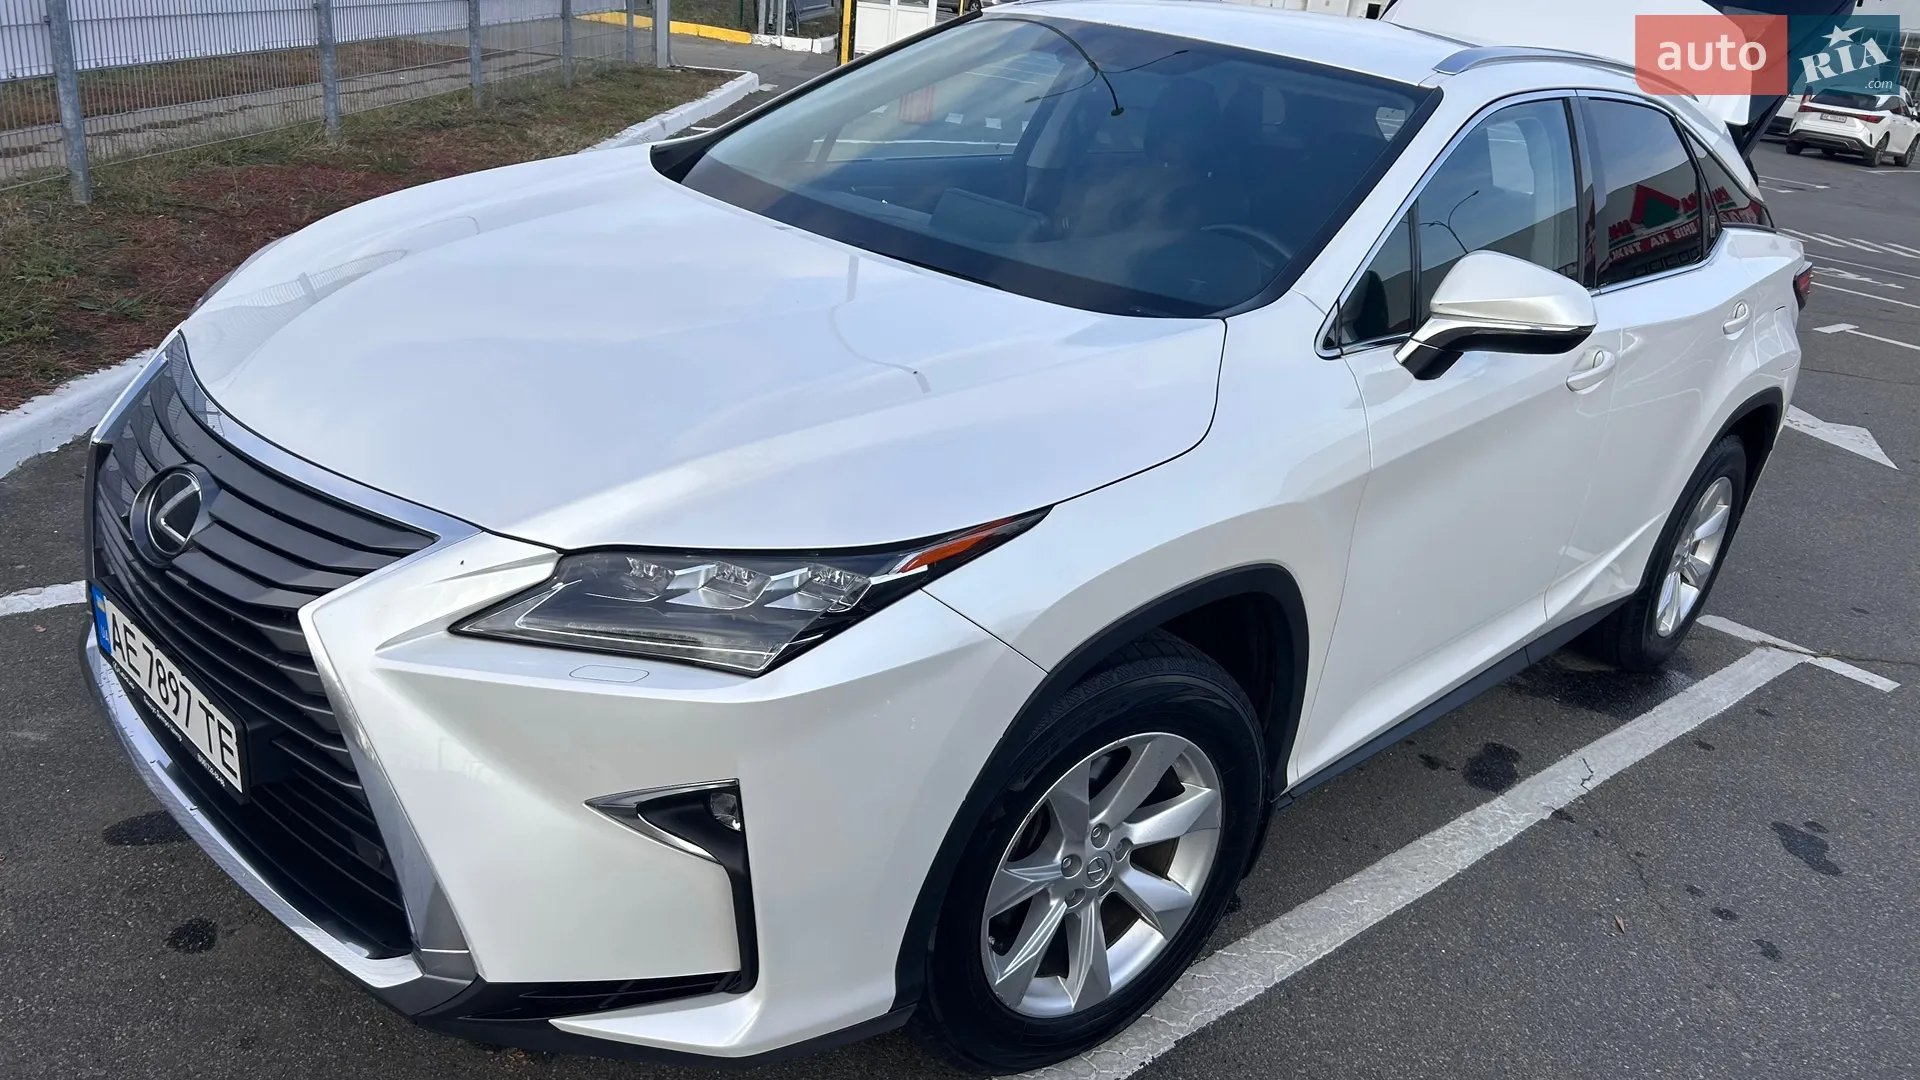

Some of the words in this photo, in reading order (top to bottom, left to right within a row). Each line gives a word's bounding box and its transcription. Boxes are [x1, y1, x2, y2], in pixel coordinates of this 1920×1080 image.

[112, 612, 141, 678] AE
[142, 642, 192, 729] 7897
[198, 699, 238, 780] TE
